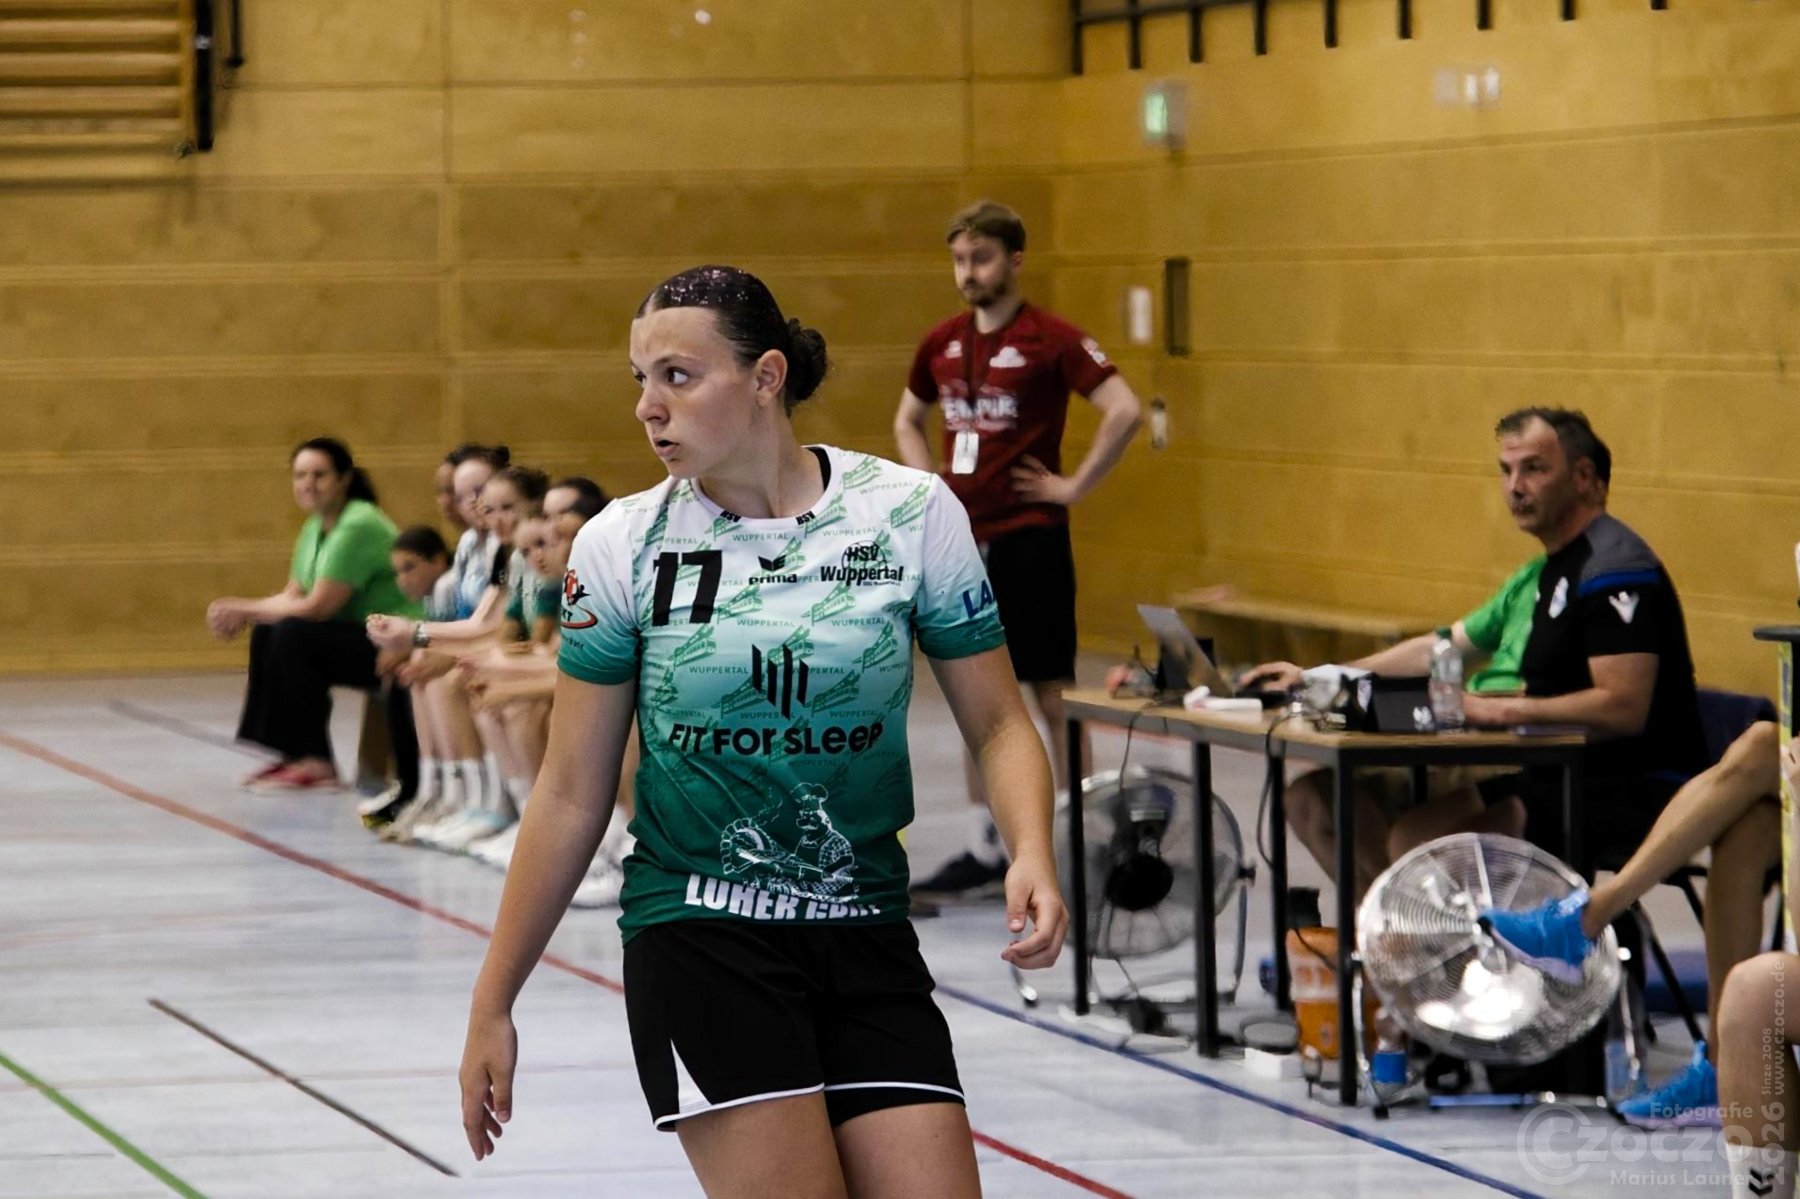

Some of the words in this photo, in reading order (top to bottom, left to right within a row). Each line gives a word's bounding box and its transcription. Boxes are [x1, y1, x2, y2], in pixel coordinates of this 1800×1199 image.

[860, 481, 914, 495] WUPPERTAL
[720, 510, 741, 523] HSV
[796, 510, 815, 525] HSV
[732, 533, 789, 541] WUPPERTAL
[823, 526, 877, 537] WUPPERTAL
[847, 545, 880, 562] HSV
[820, 566, 904, 586] Wuppertal
[652, 550, 723, 627] 17
[737, 619, 796, 627] WUPPERTAL
[831, 617, 885, 627] WUPPERTAL
[689, 665, 748, 674] WUPPERTAL
[668, 723, 708, 753] FIT
